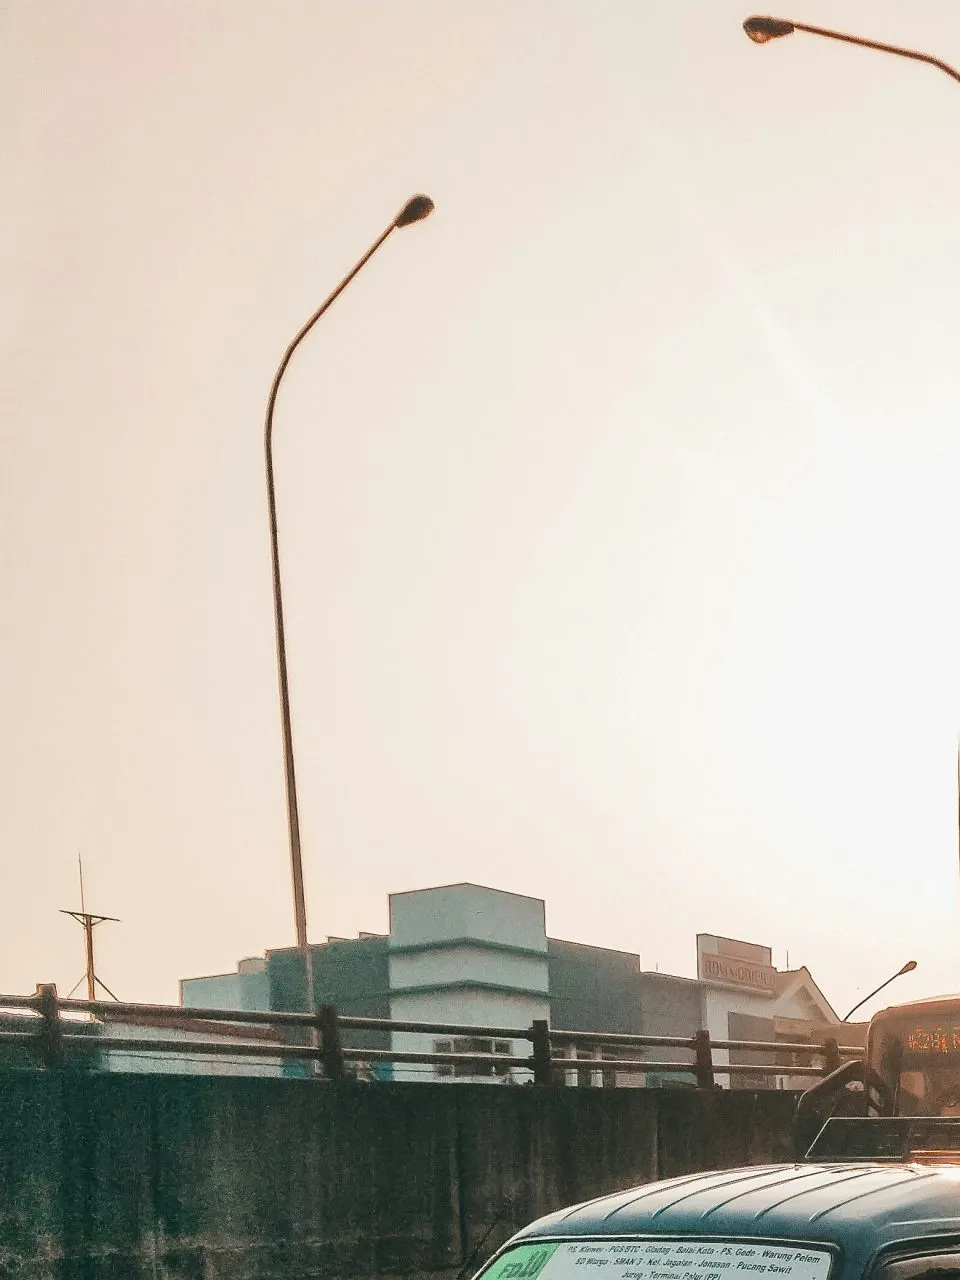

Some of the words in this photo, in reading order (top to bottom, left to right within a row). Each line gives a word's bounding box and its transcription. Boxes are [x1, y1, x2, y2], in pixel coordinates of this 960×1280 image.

[697, 1247, 715, 1255] Kota
[735, 1248, 757, 1258] Gede
[762, 1249, 793, 1261] Warung
[794, 1252, 821, 1264] Pelem
[613, 1257, 636, 1266] SMAN
[736, 1262, 767, 1273] Pucang
[767, 1264, 793, 1275] Sawit
[621, 1271, 644, 1280] Jurug
[649, 1271, 682, 1280] Terminal
